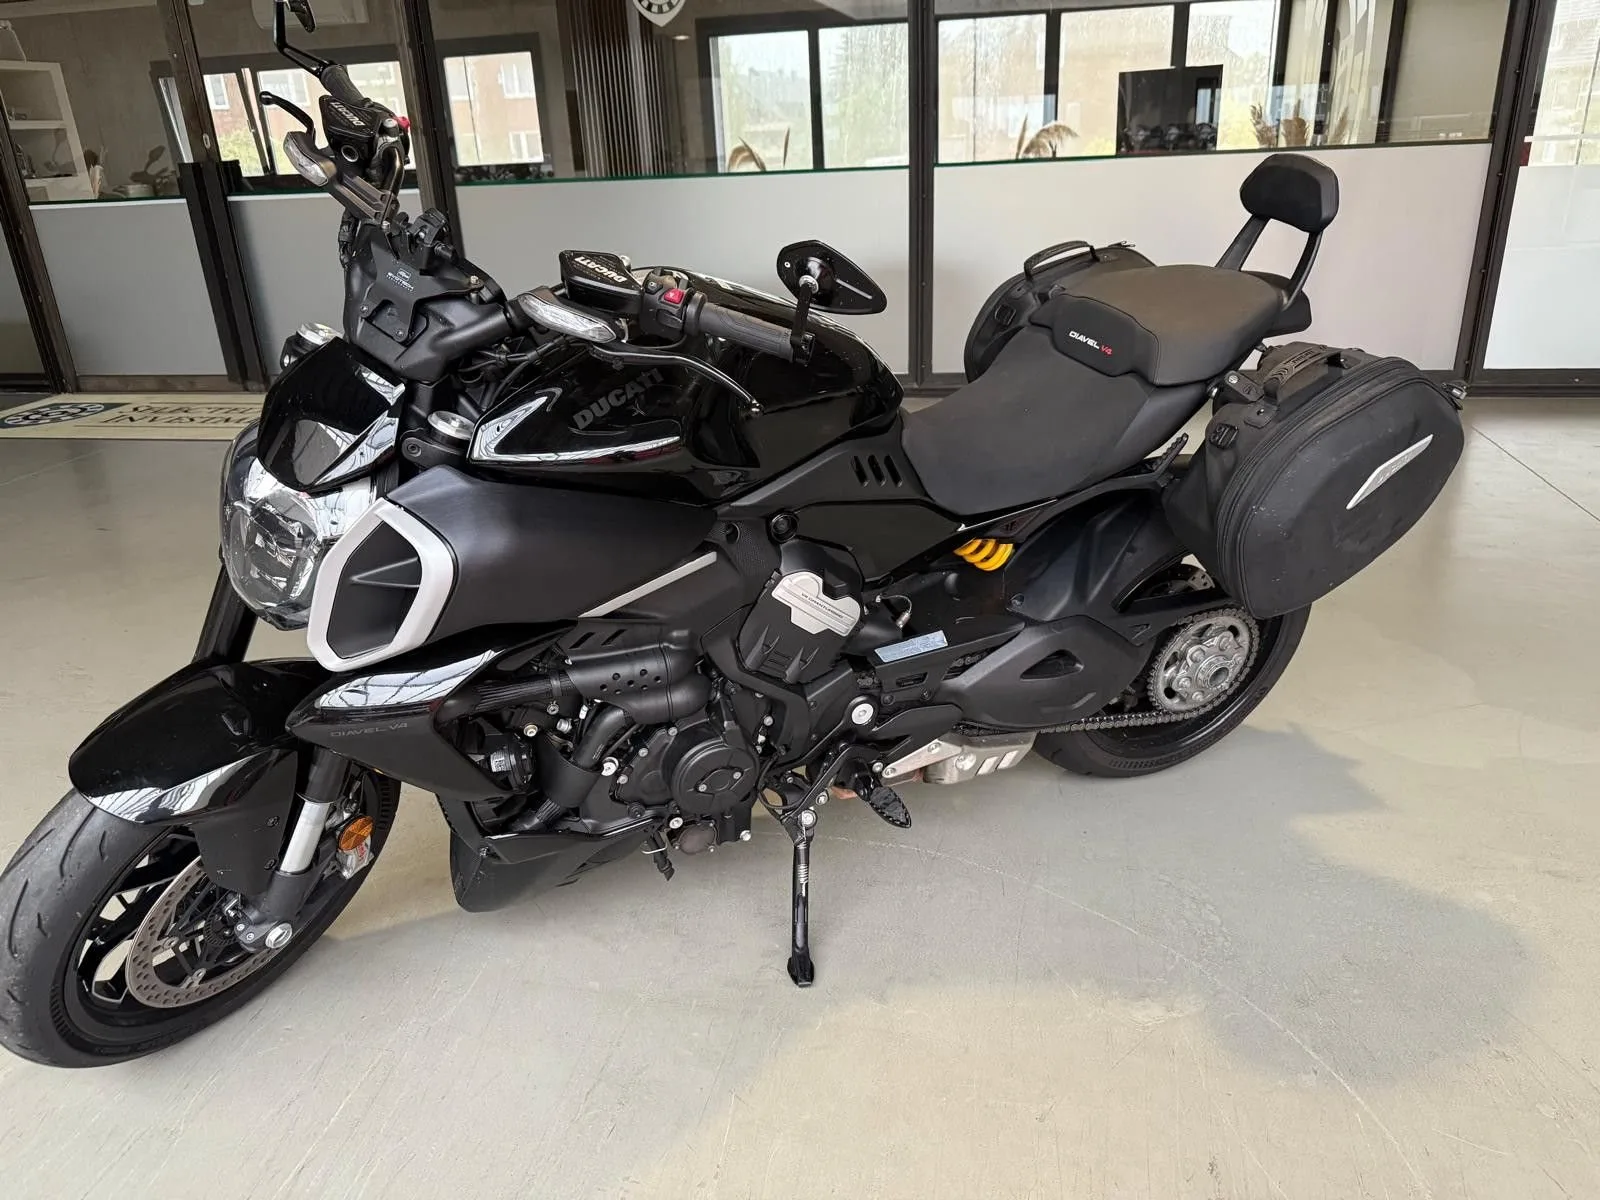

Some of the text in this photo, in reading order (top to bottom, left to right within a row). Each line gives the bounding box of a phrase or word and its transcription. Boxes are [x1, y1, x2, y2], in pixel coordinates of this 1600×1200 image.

[330, 102, 366, 126] DUCATI
[574, 256, 628, 283] DUCATI
[1068, 330, 1113, 355] DIAVEL V4
[572, 367, 665, 430] DUCATI
[99, 414, 257, 424] INVESTM
[330, 722, 408, 737] DIAVEL V4
